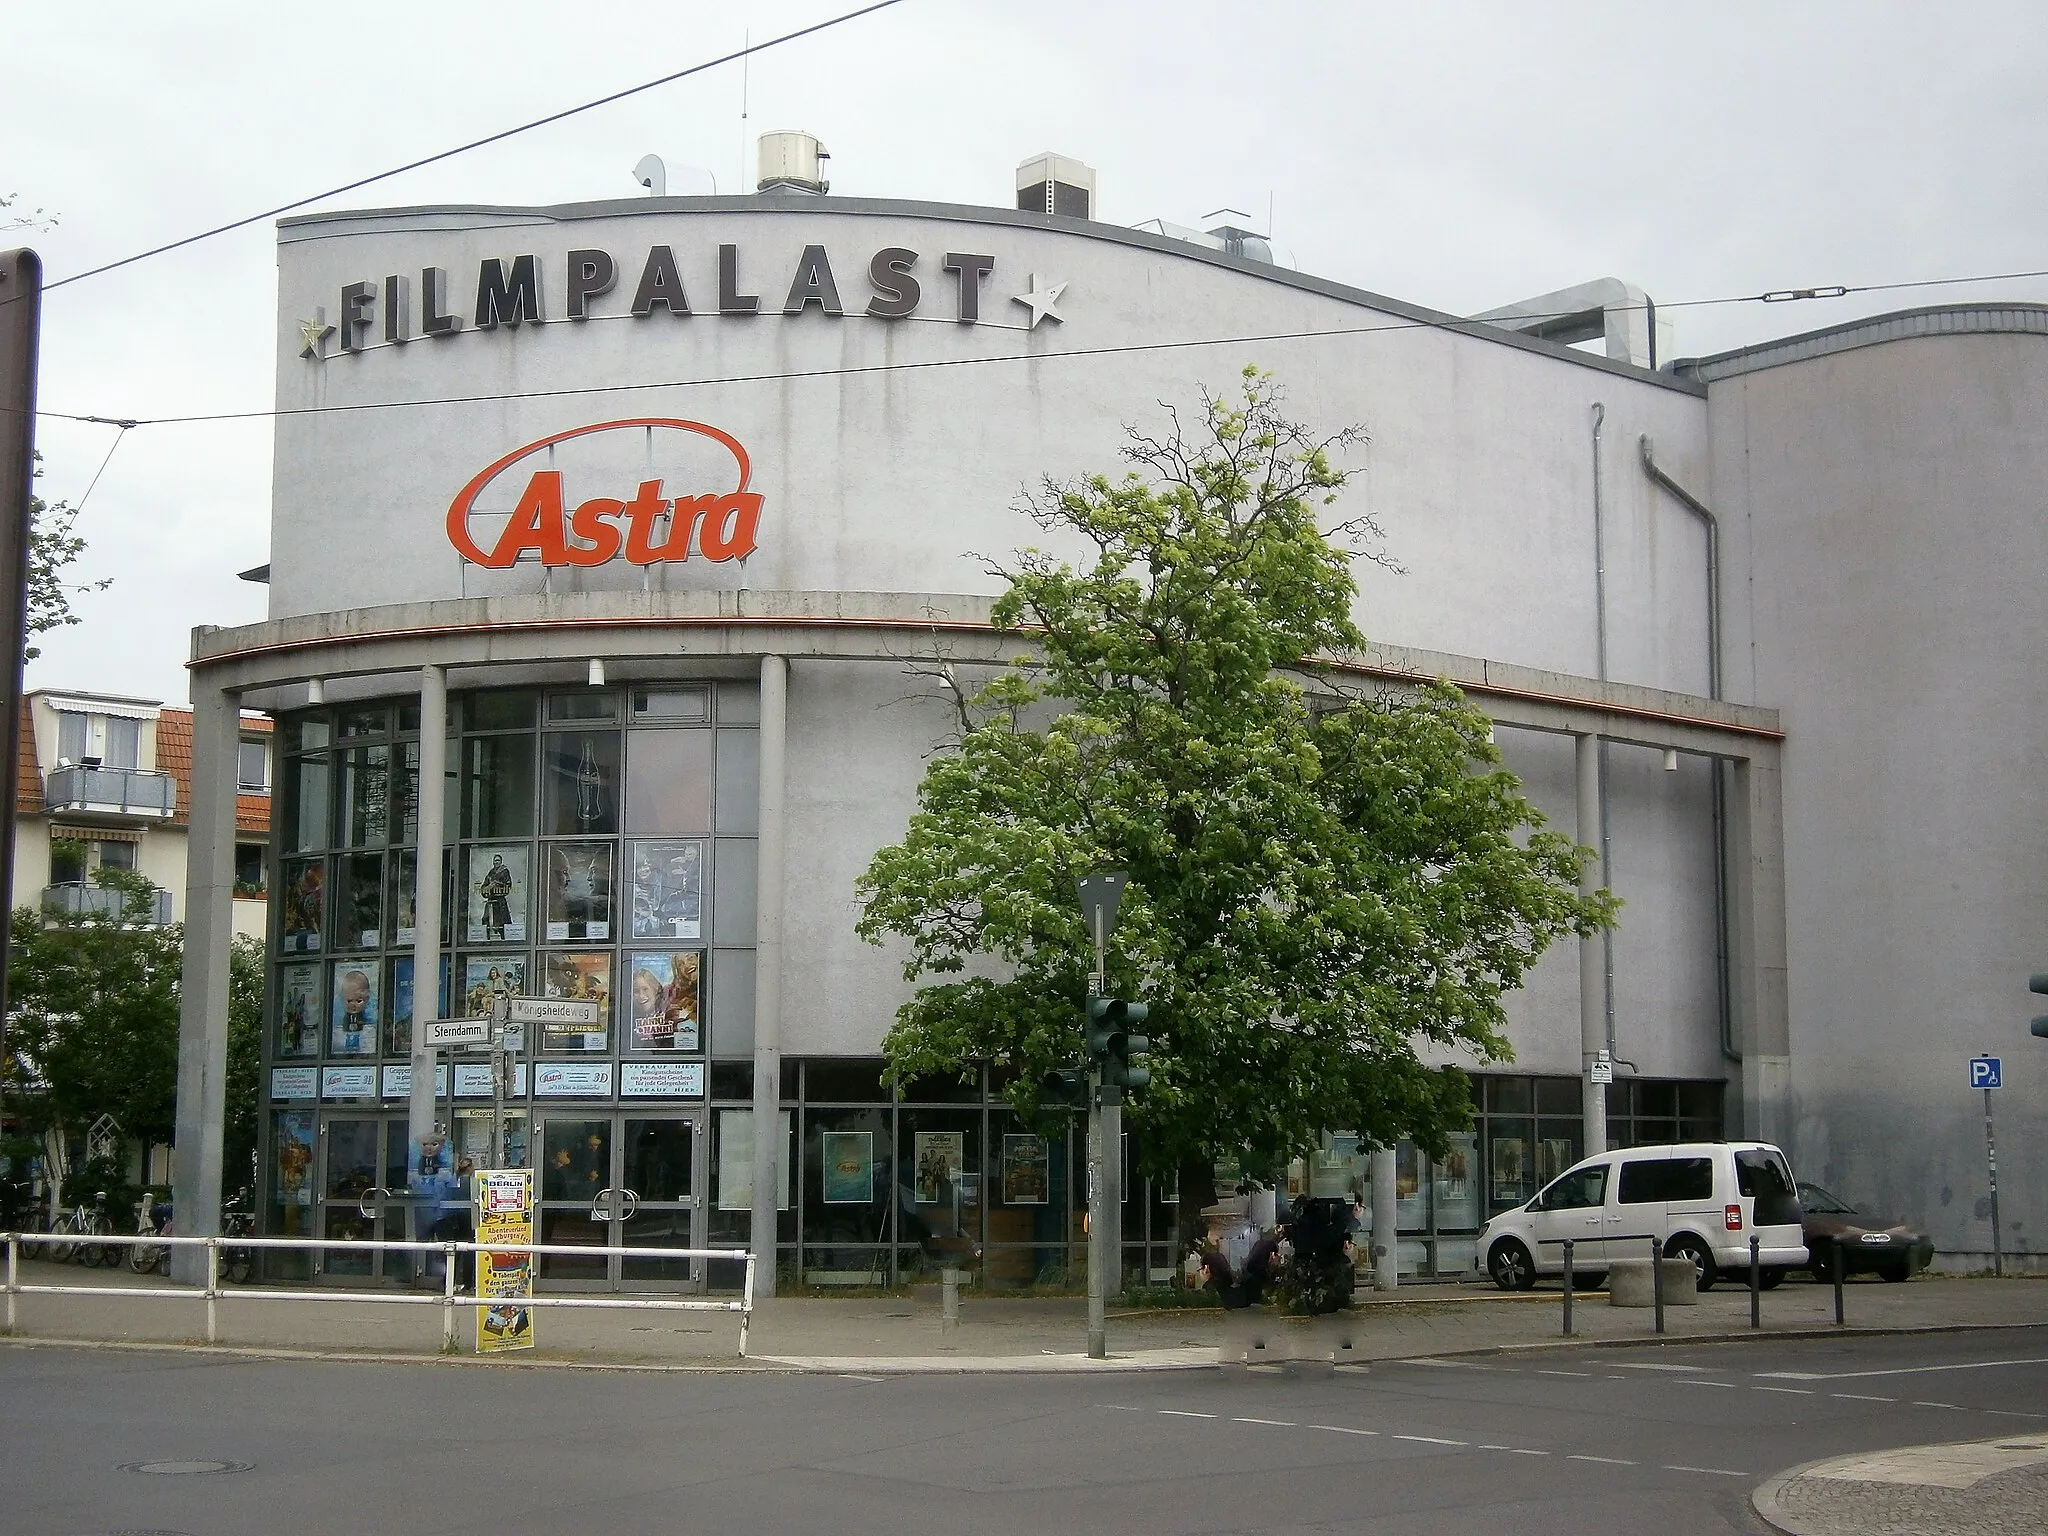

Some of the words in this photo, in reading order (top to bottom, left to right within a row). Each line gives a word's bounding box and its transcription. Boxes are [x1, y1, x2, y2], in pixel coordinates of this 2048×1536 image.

[339, 244, 995, 352] FILMPALAST
[488, 469, 765, 568] Astra
[434, 1024, 482, 1038] Sterndamm
[593, 1072, 609, 1084] 3D
[1972, 1062, 1990, 1085] P
